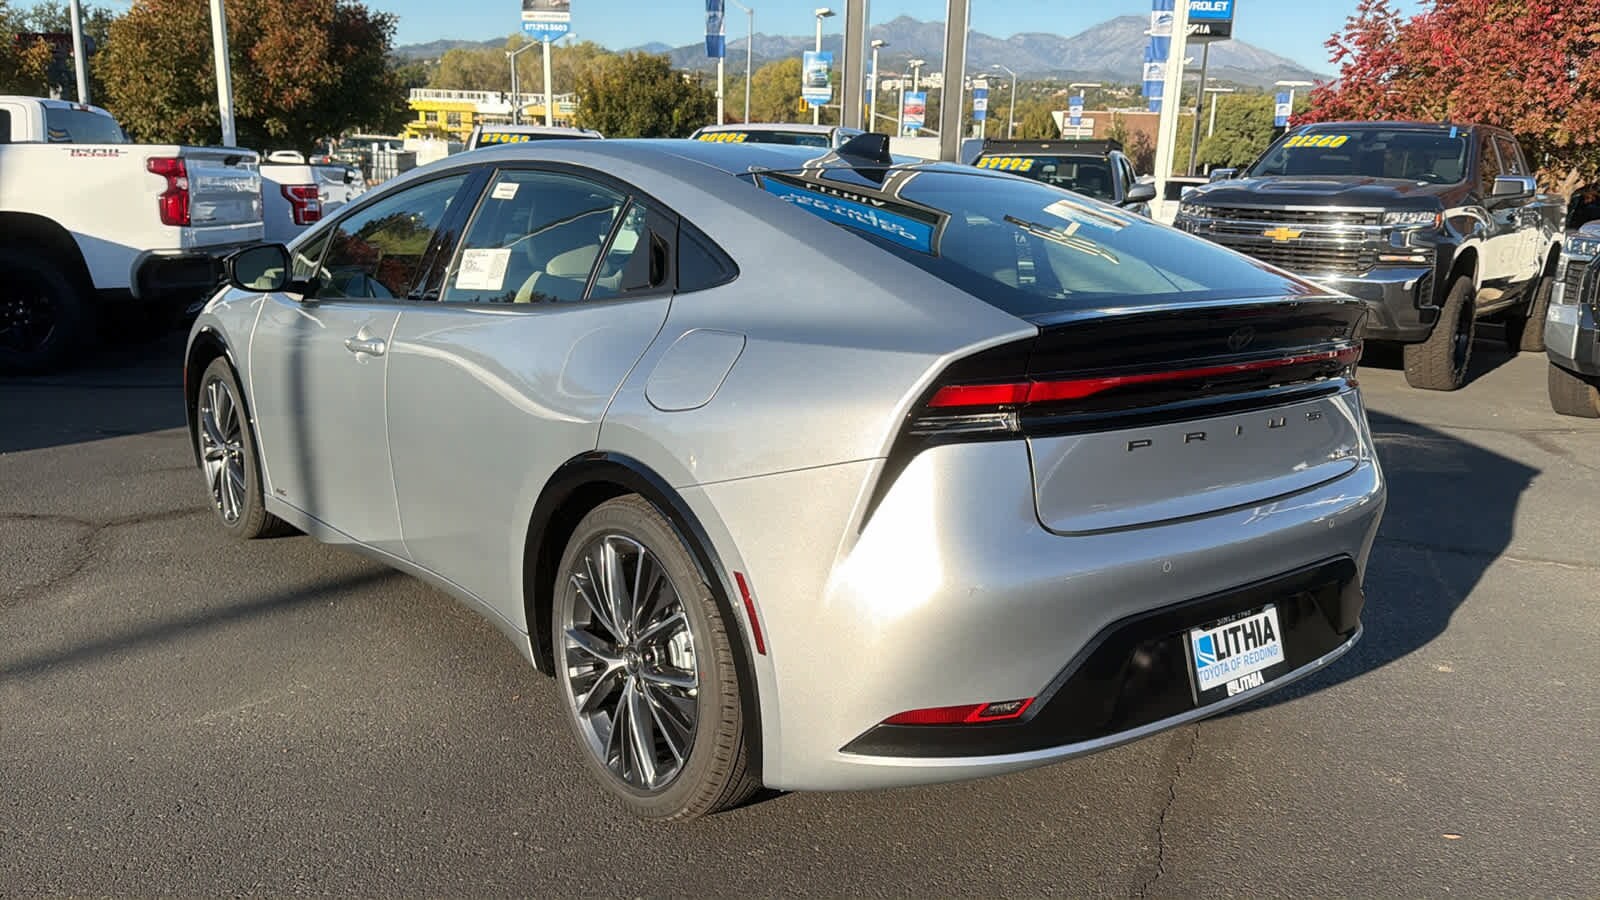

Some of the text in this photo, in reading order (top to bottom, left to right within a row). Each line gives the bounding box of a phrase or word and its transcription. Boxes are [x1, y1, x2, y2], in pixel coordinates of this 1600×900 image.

[1127, 411, 1321, 451] PRIUS
[1212, 615, 1276, 662] LITHIA
[1198, 644, 1279, 683] TOYOTA OF REDDING
[1236, 671, 1264, 691] LITHIA
